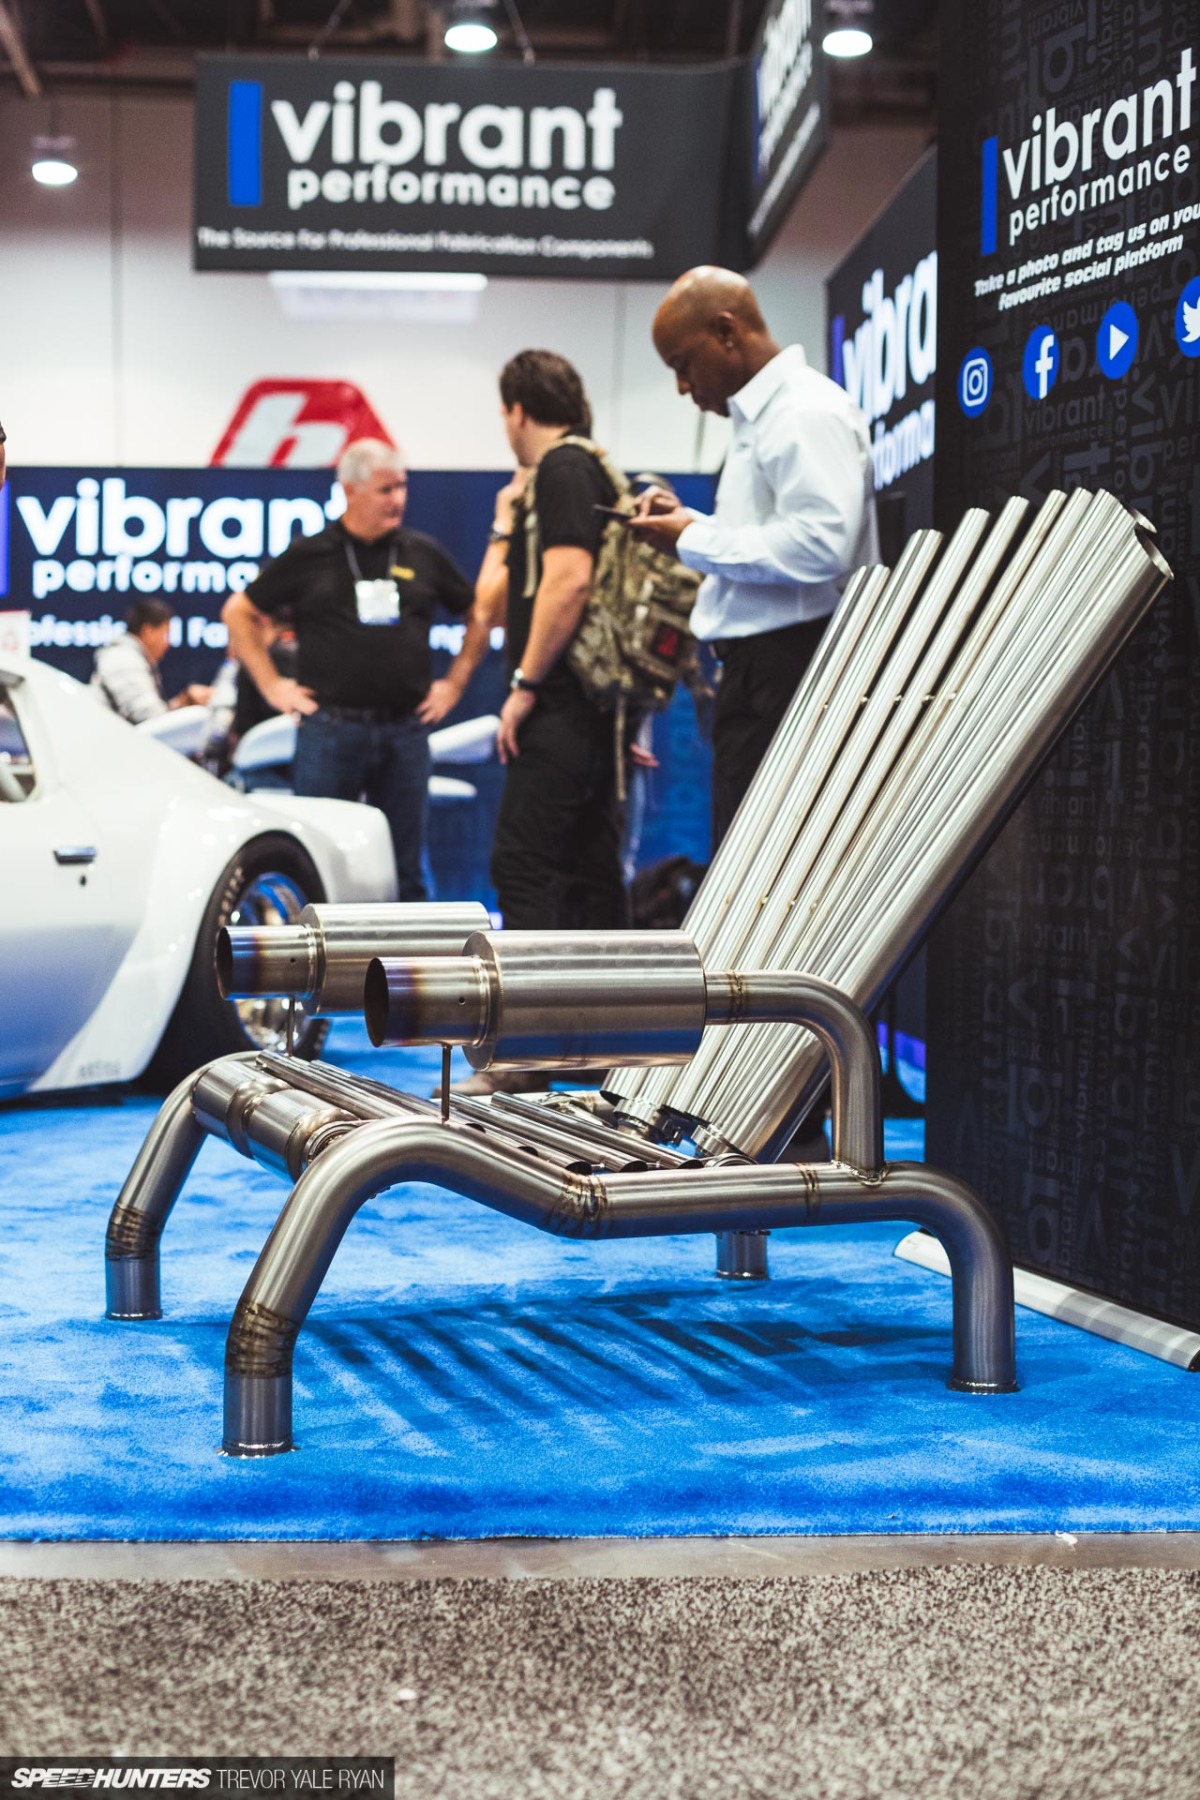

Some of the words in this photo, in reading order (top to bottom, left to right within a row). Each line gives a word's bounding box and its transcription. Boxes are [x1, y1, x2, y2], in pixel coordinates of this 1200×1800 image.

[271, 81, 623, 170] vibrant
[1002, 48, 1197, 200] vibrant
[287, 164, 617, 210] performance
[1009, 143, 1192, 246] performance
[197, 226, 231, 249] The
[974, 273, 1005, 297] Take
[1006, 269, 1017, 286] a
[1017, 253, 1059, 284] photo
[1062, 239, 1094, 265] and
[1095, 230, 1125, 255] tag
[1127, 222, 1147, 244] us
[1149, 214, 1170, 235] on
[1172, 203, 1200, 233] you
[997, 274, 1062, 311] favourite
[1063, 256, 1112, 288] social
[1113, 234, 1185, 275] platform
[842, 250, 938, 425] vibra
[32, 555, 260, 599] performa
